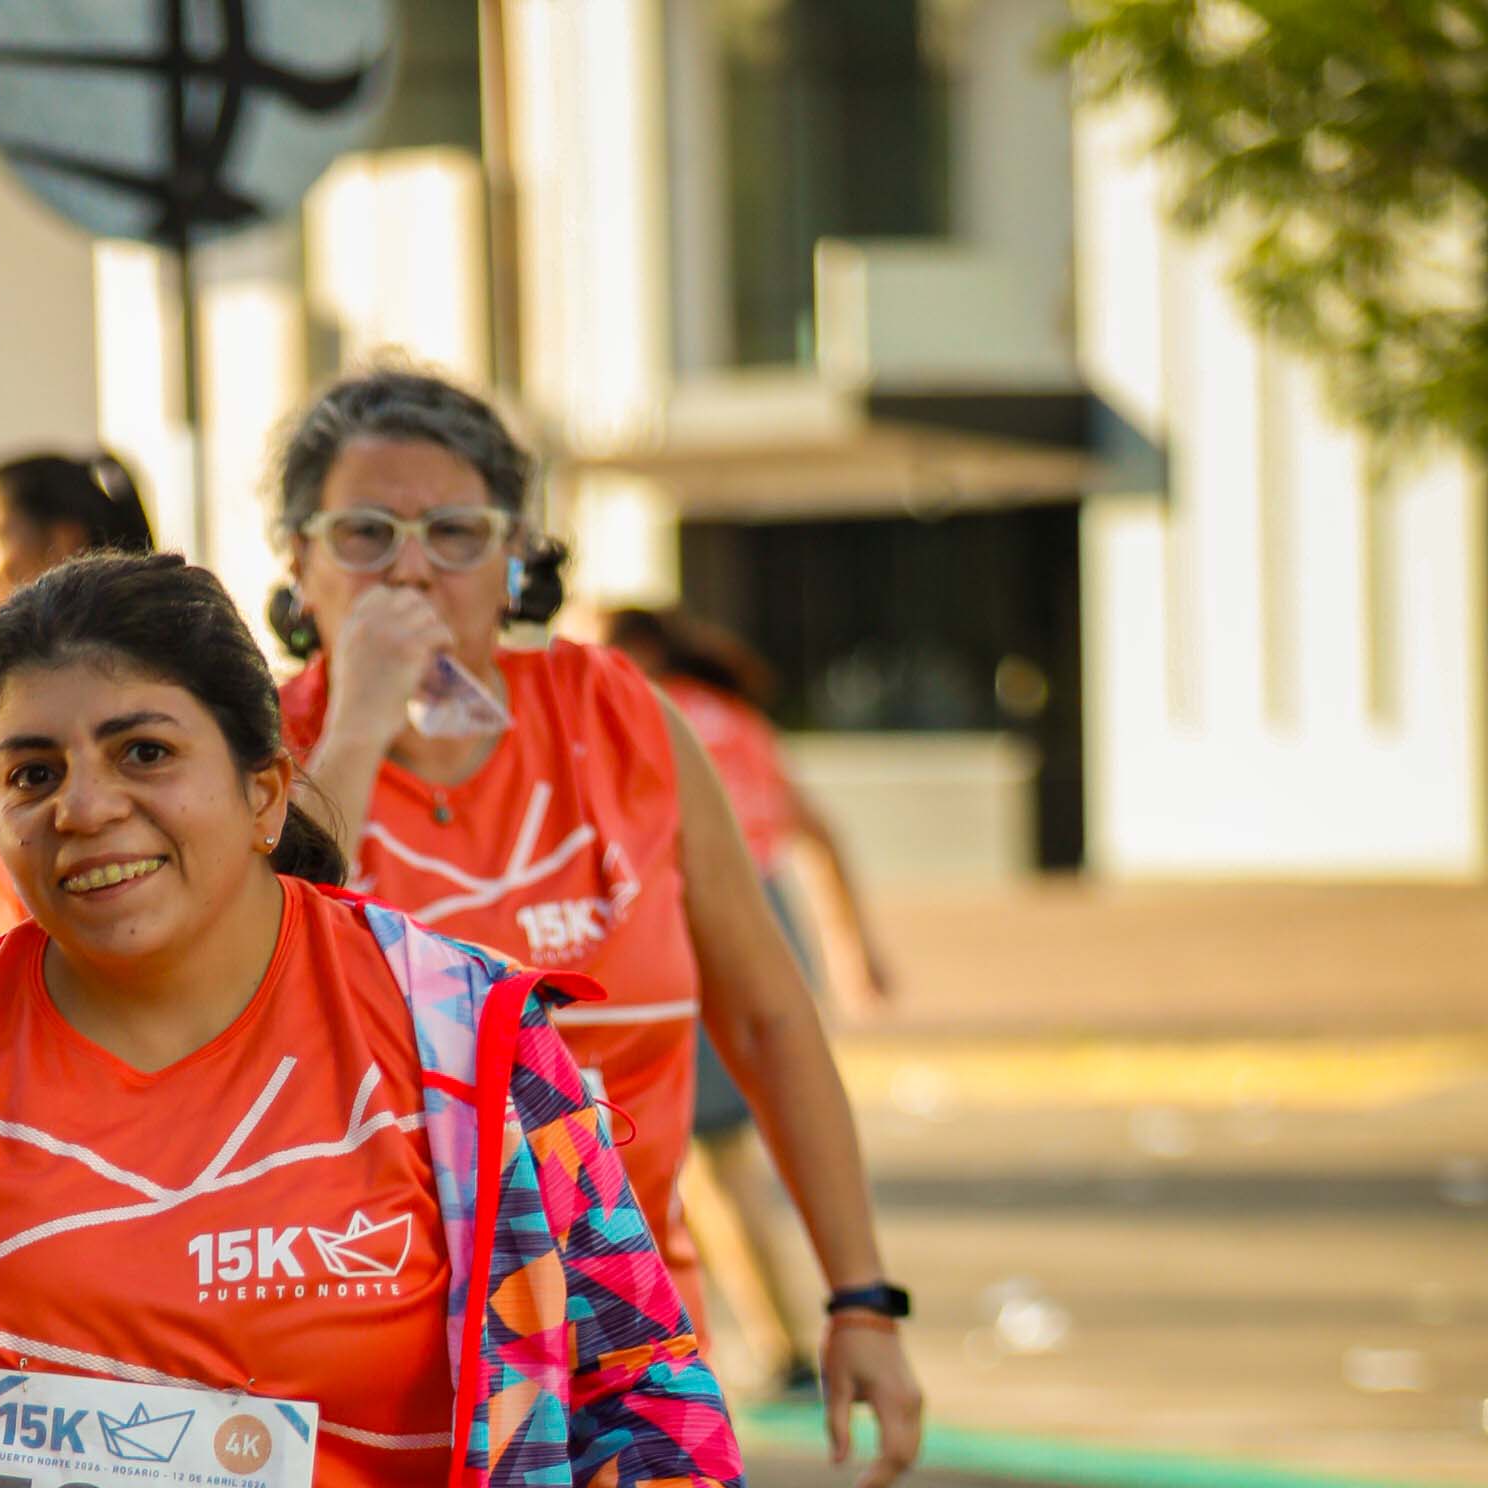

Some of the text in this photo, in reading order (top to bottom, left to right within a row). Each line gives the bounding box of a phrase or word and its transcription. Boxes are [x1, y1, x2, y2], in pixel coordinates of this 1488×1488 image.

[516, 901, 605, 949] 15K
[188, 1226, 305, 1286] 15K
[199, 1284, 400, 1304] PUERTO NORTE
[224, 1428, 261, 1458] 4K
[37, 1456, 71, 1469] NORTE
[112, 1464, 160, 1479] ROSARIO
[173, 1472, 185, 1482] 12
[189, 1473, 203, 1483] DE
[206, 1475, 238, 1488] ABRIL
